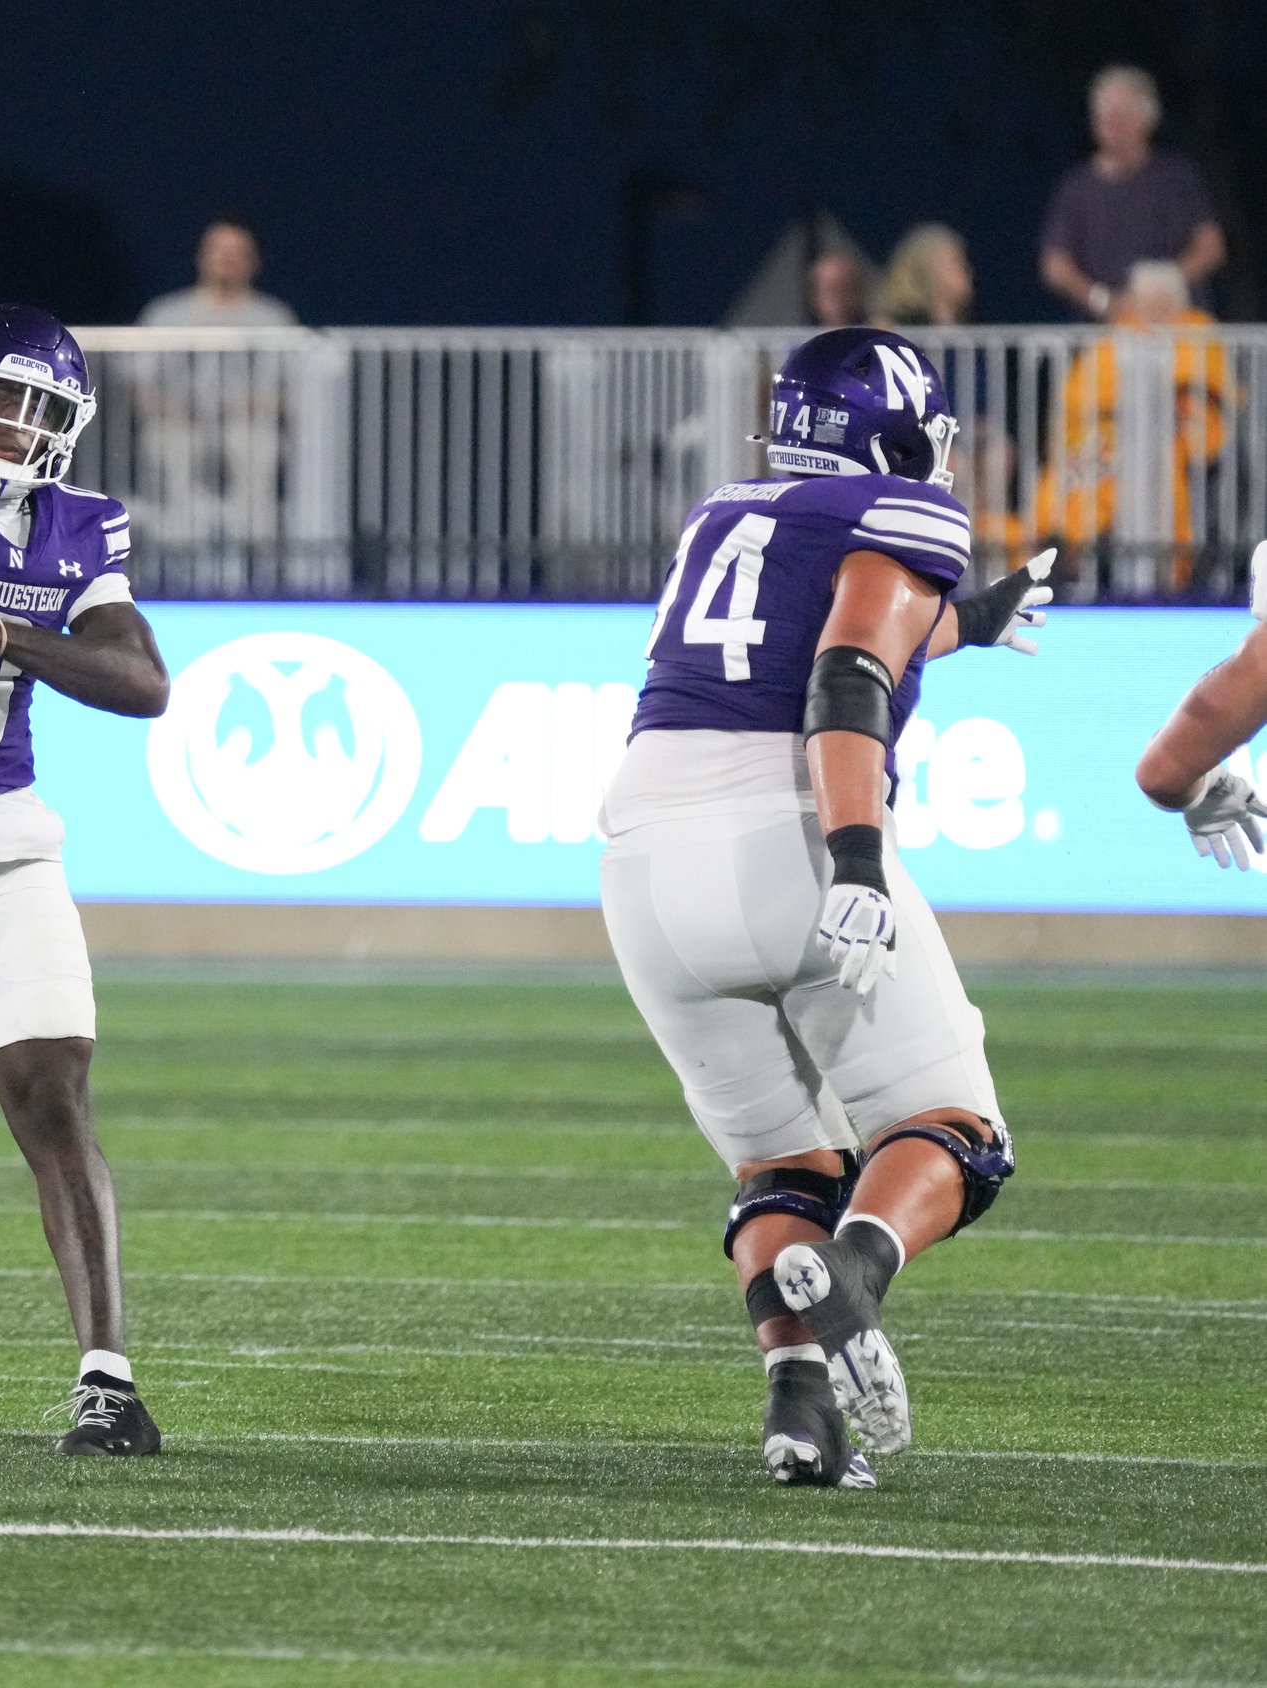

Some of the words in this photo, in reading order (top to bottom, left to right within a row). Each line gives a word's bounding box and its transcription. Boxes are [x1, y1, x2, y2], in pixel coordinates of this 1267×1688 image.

[10, 355, 49, 374] WILDCATS
[874, 344, 926, 420] N
[776, 400, 811, 439] 74
[9, 547, 24, 570] N
